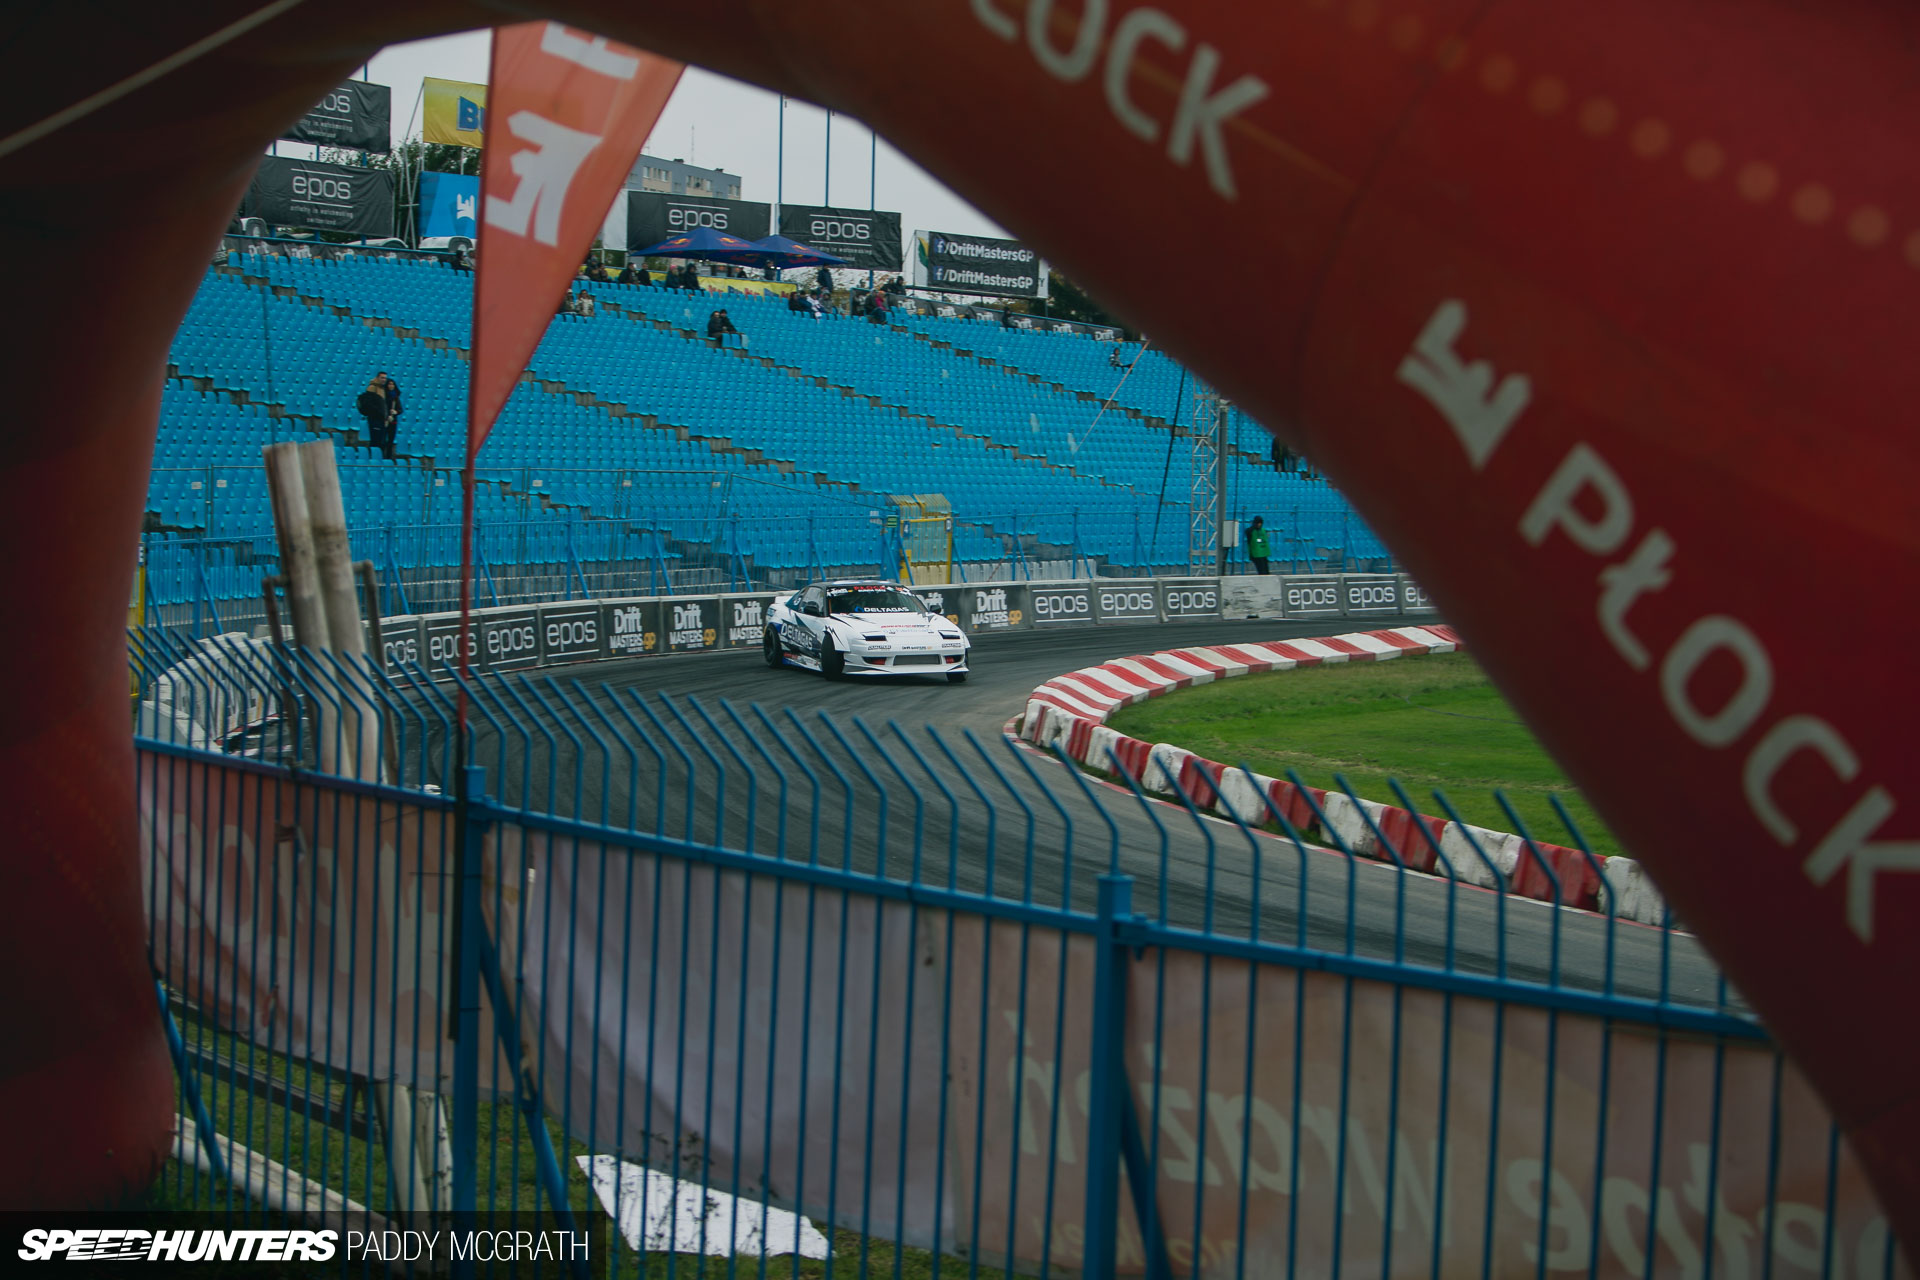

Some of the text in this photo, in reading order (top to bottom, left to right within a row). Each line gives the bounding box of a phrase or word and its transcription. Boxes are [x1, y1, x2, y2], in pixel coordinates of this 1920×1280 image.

[314, 93, 350, 113] os
[970, 0, 1270, 204] OCK
[456, 95, 485, 134] B
[293, 176, 351, 201] epos
[669, 209, 728, 231] epos
[811, 220, 870, 241] epos
[943, 268, 1033, 289] /DriftMastersGP
[976, 588, 1007, 612] Drift
[1035, 594, 1088, 618] epos
[1100, 593, 1154, 615] epos
[1167, 591, 1217, 613] epos
[1288, 588, 1337, 609] epos
[1349, 586, 1396, 607] epos
[1405, 586, 1428, 607] ep
[614, 606, 643, 634] Drift
[673, 603, 702, 630] Drift
[734, 600, 763, 627] Drift
[971, 611, 1008, 625] MASTERS
[487, 626, 535, 659] epos
[547, 620, 597, 652] epos
[609, 633, 644, 649] MASTERS
[669, 629, 704, 645] MASTERS
[729, 626, 764, 641] MASTERS
[383, 638, 417, 675] pos
[1517, 442, 1920, 946] PŁOCK
